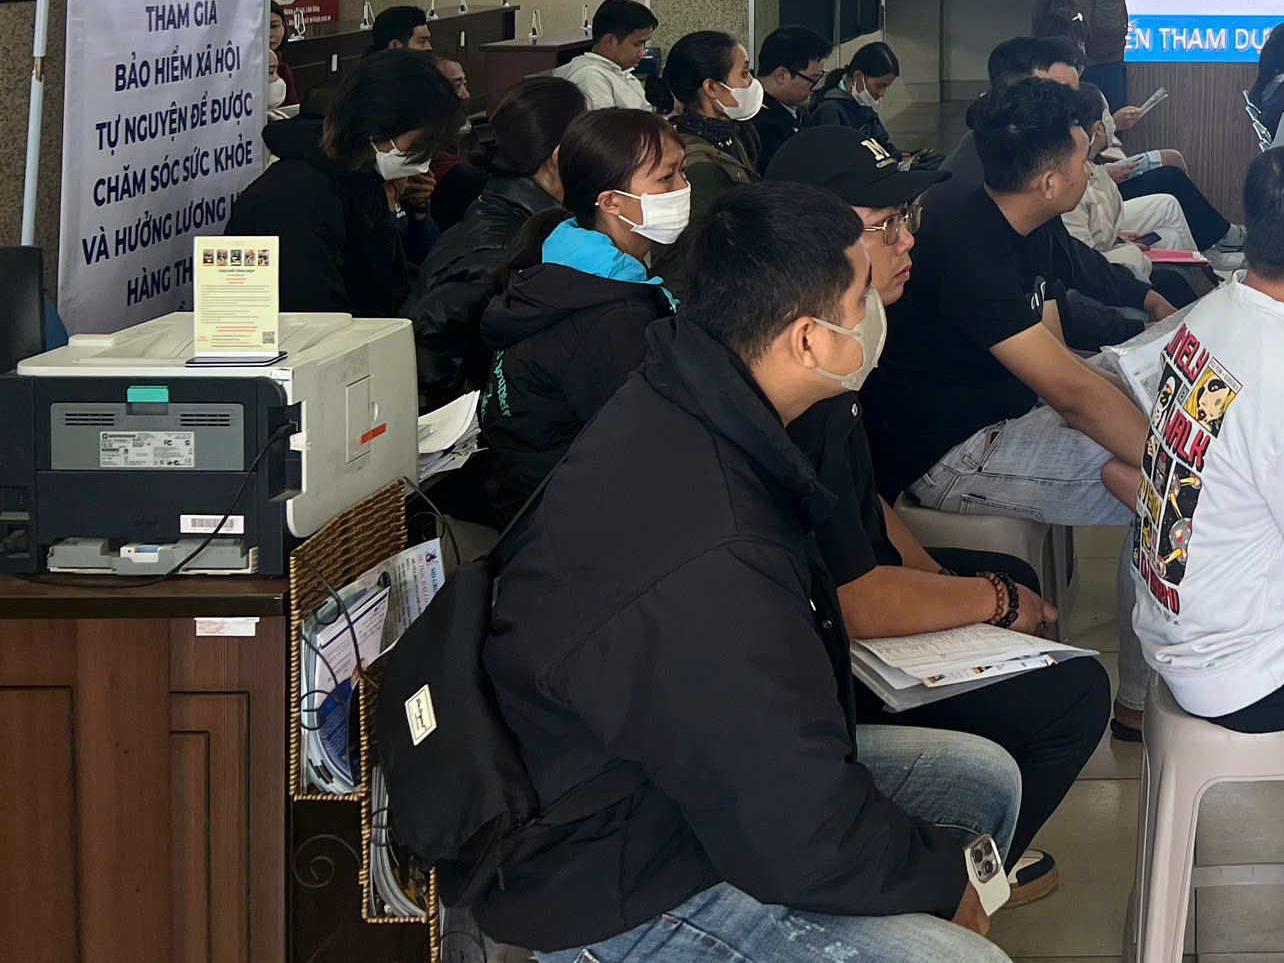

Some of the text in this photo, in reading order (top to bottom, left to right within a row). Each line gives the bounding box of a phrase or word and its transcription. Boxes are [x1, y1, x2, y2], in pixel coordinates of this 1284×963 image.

[145, 0, 218, 32] THAM GIA
[1124, 18, 1150, 51] ẾN
[1159, 27, 1226, 51] THAM
[115, 40, 241, 93] BẢO HIỂM XÃ HỘI
[96, 89, 253, 156] TỰ NGUYỆN ĐỂ ĐƯỢC
[93, 133, 253, 207] CHĂM SÓC SỨC KHỎE
[82, 197, 226, 265] VÀ HƯỞNG LƯƠNG
[127, 266, 171, 307] HÀNG
